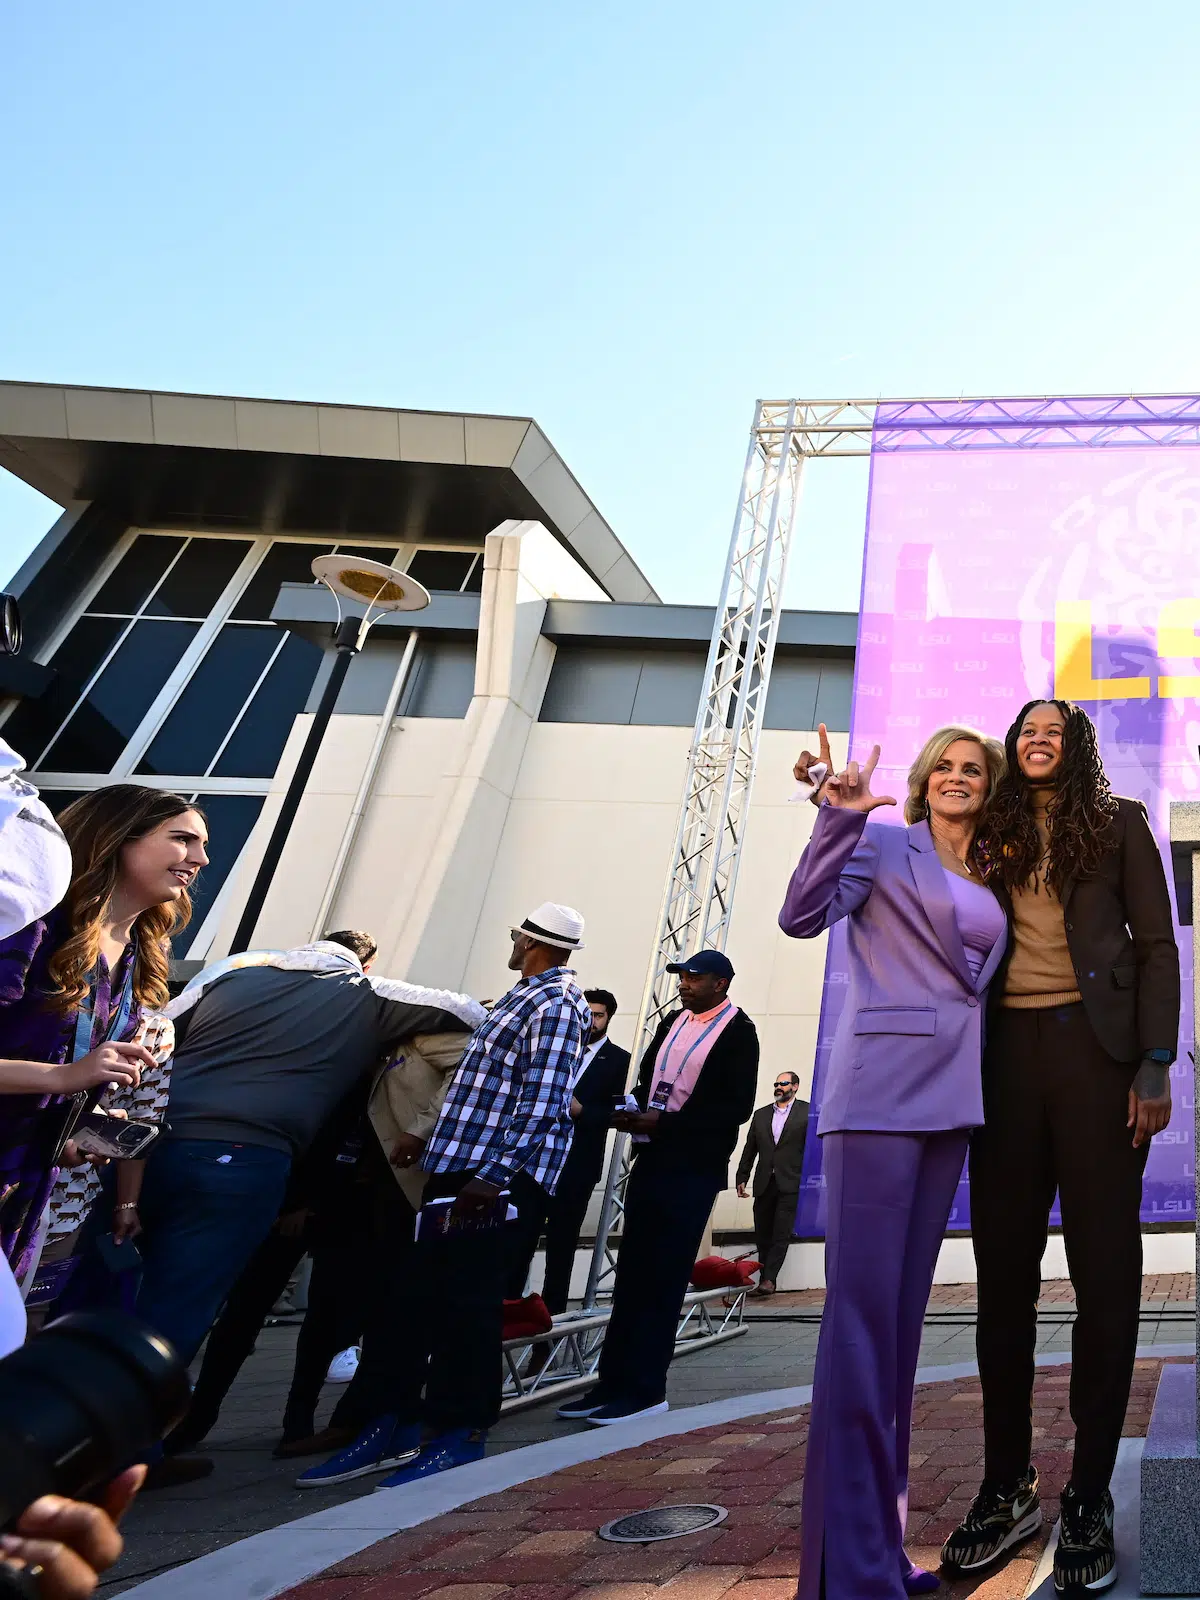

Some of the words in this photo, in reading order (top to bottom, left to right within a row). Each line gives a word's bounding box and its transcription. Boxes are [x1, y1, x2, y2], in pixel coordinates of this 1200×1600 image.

[918, 634, 951, 646] LSU
[982, 632, 1016, 644] LSU
[890, 662, 923, 673] LSU
[954, 661, 988, 672] LSU
[916, 687, 949, 699] LSU
[980, 687, 1015, 698] LSU
[887, 715, 920, 726] LSU
[953, 715, 985, 726] LSU
[1152, 1131, 1189, 1145] LSU
[1153, 1200, 1191, 1213] LSU
